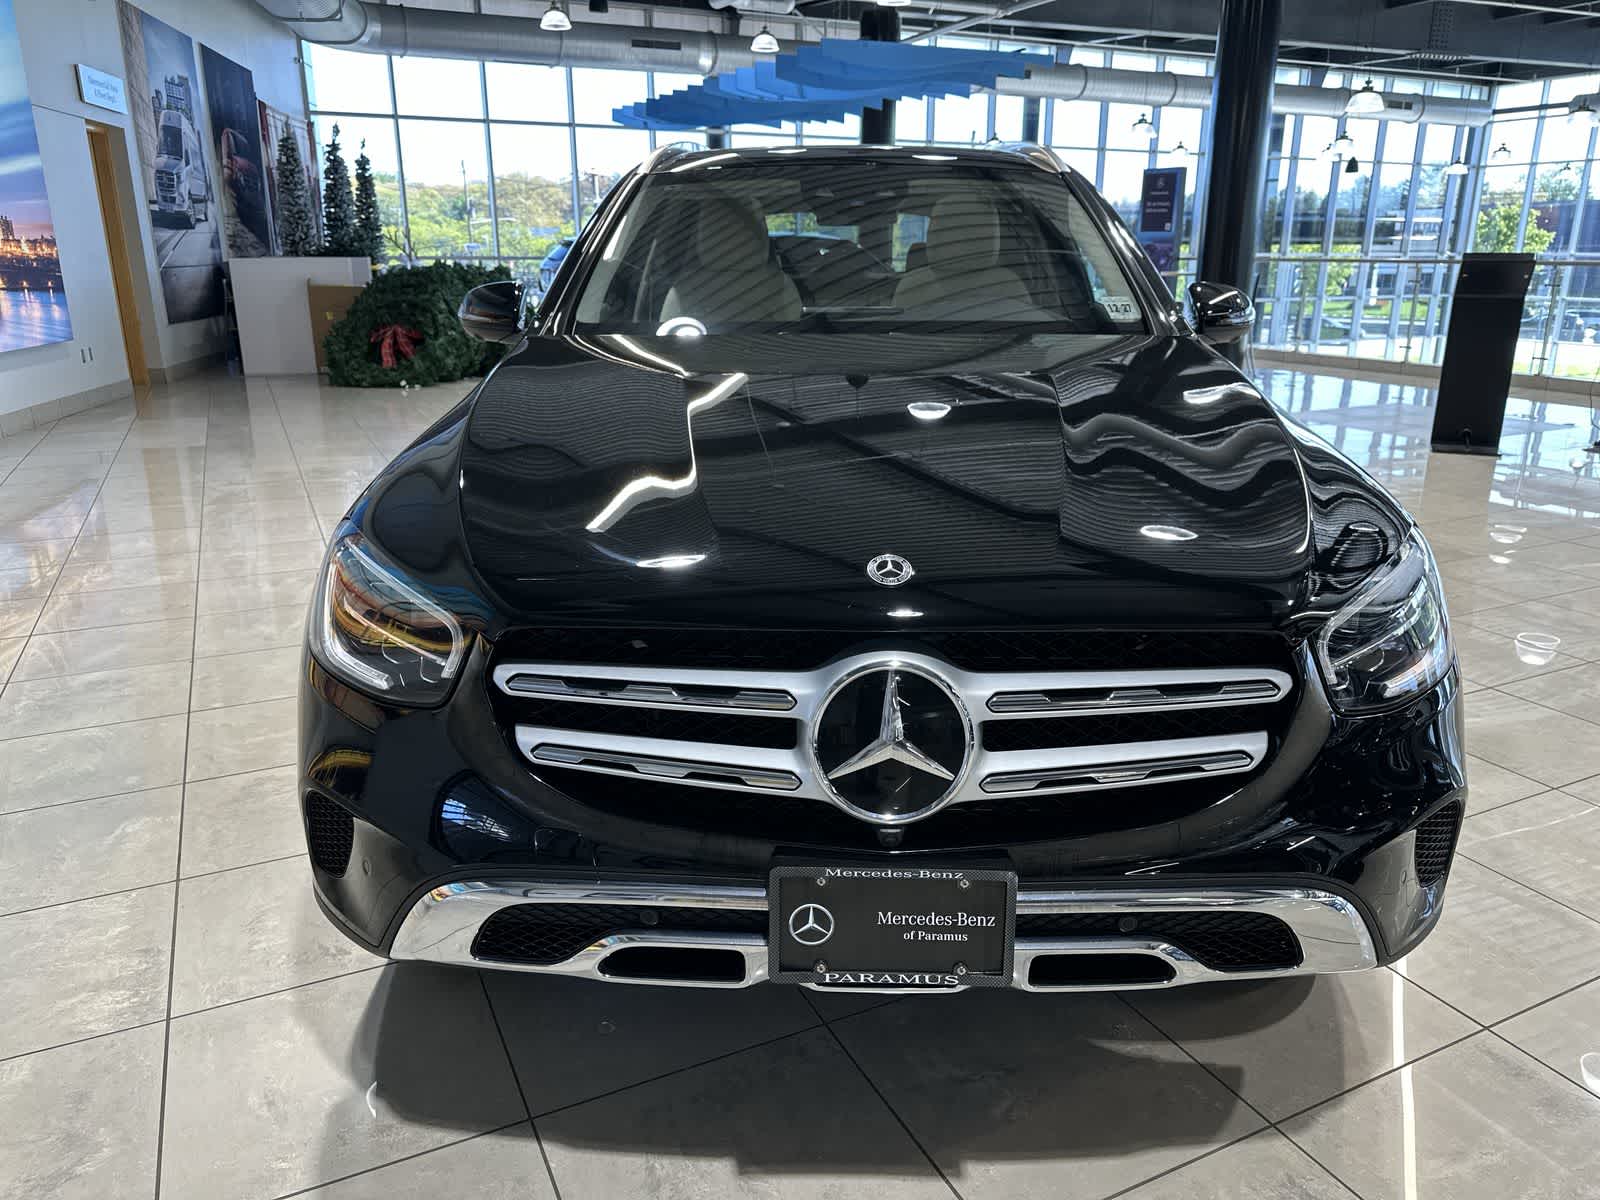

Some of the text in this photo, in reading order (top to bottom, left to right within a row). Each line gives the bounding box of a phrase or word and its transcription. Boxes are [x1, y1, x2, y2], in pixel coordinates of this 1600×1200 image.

[824, 868, 964, 880] Mercedes-Benz
[877, 911, 996, 927] Mercedes-Benz
[903, 930, 968, 942] of Paramus
[823, 973, 959, 985] PARAMUS
